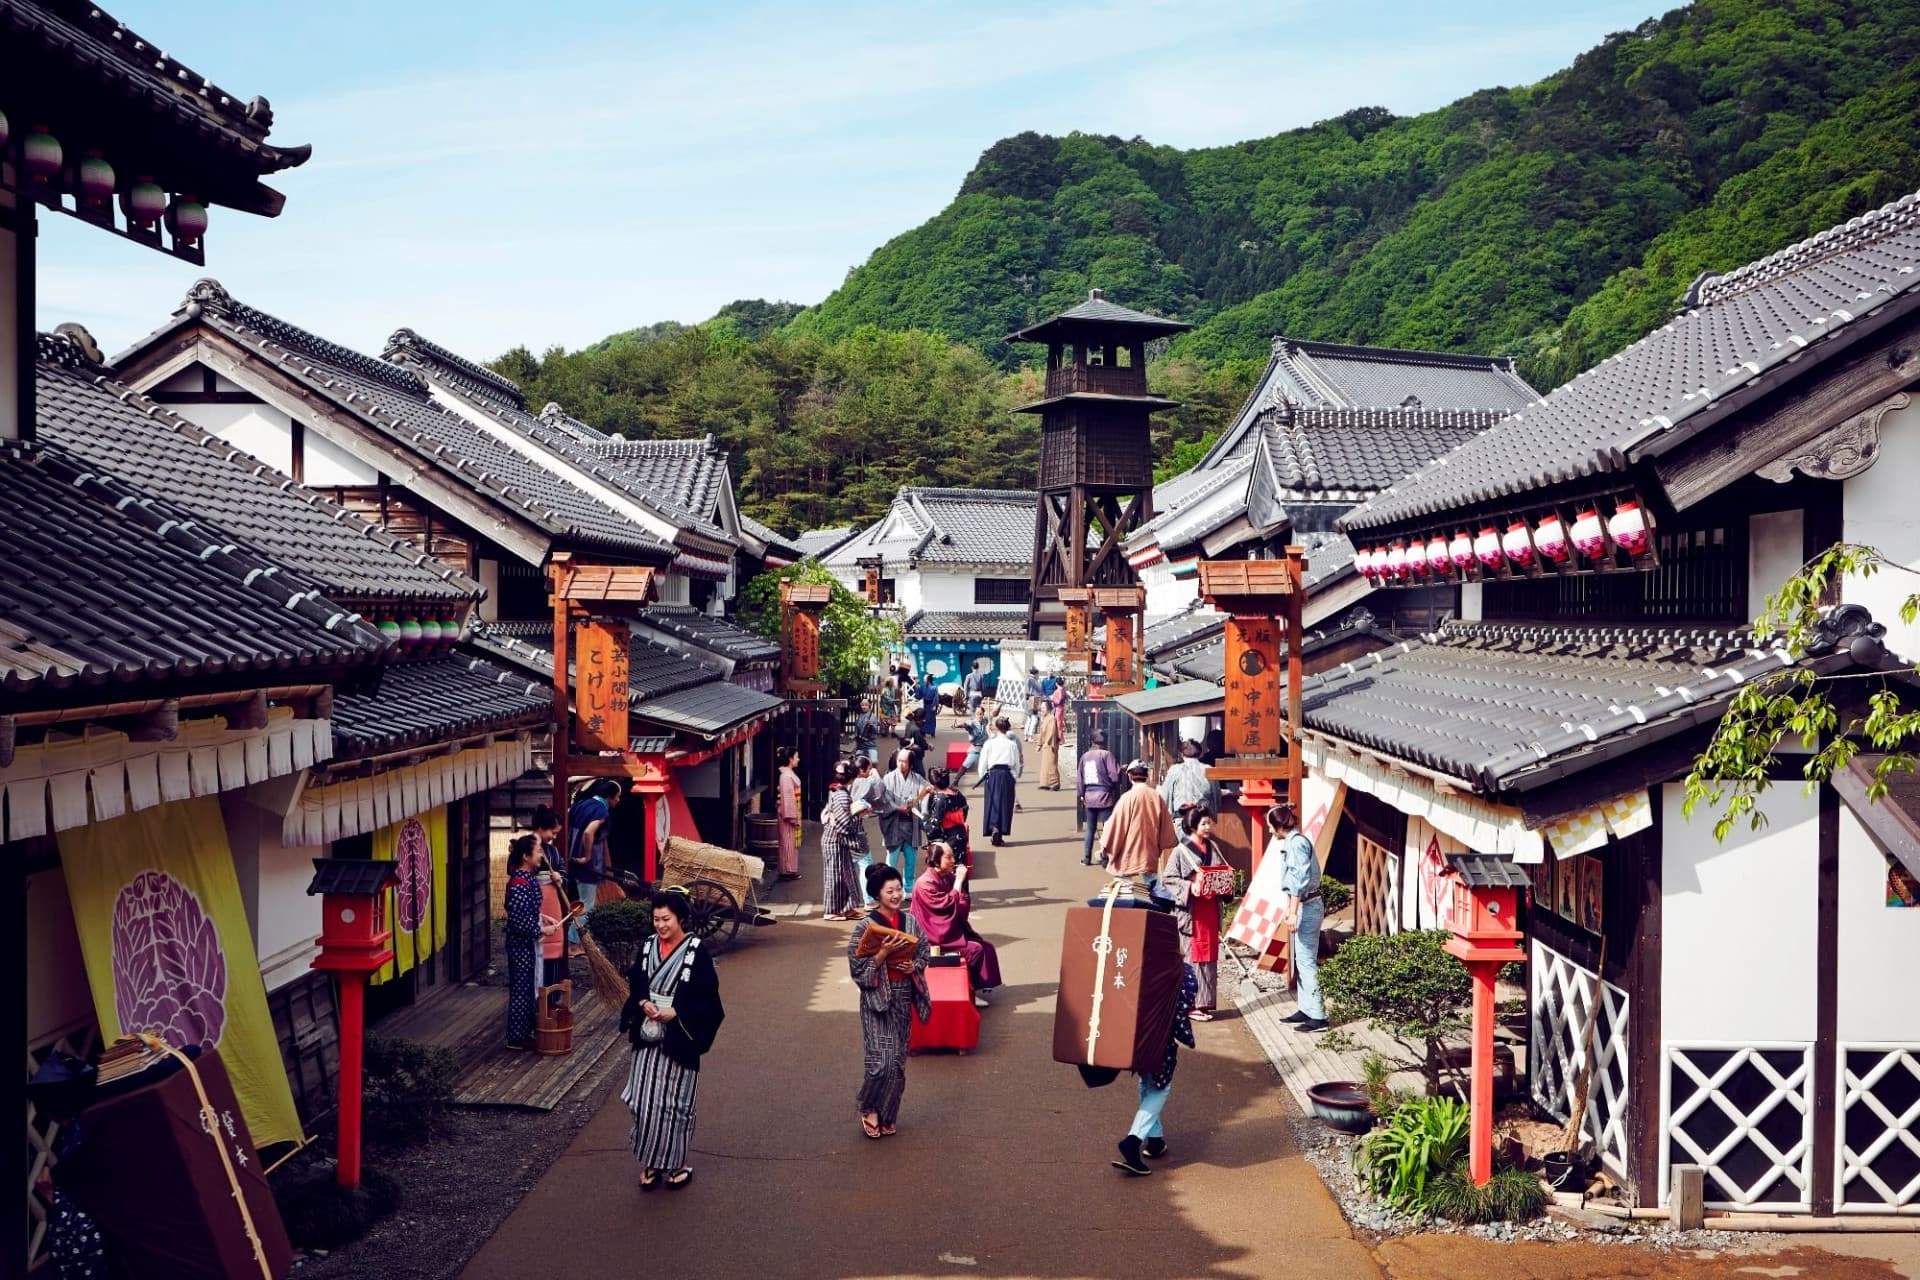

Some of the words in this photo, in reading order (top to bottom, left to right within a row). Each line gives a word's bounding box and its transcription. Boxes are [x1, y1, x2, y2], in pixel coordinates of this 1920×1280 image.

[586, 649, 606, 735] こけし堂
[609, 631, 628, 713] 民芸小間物
